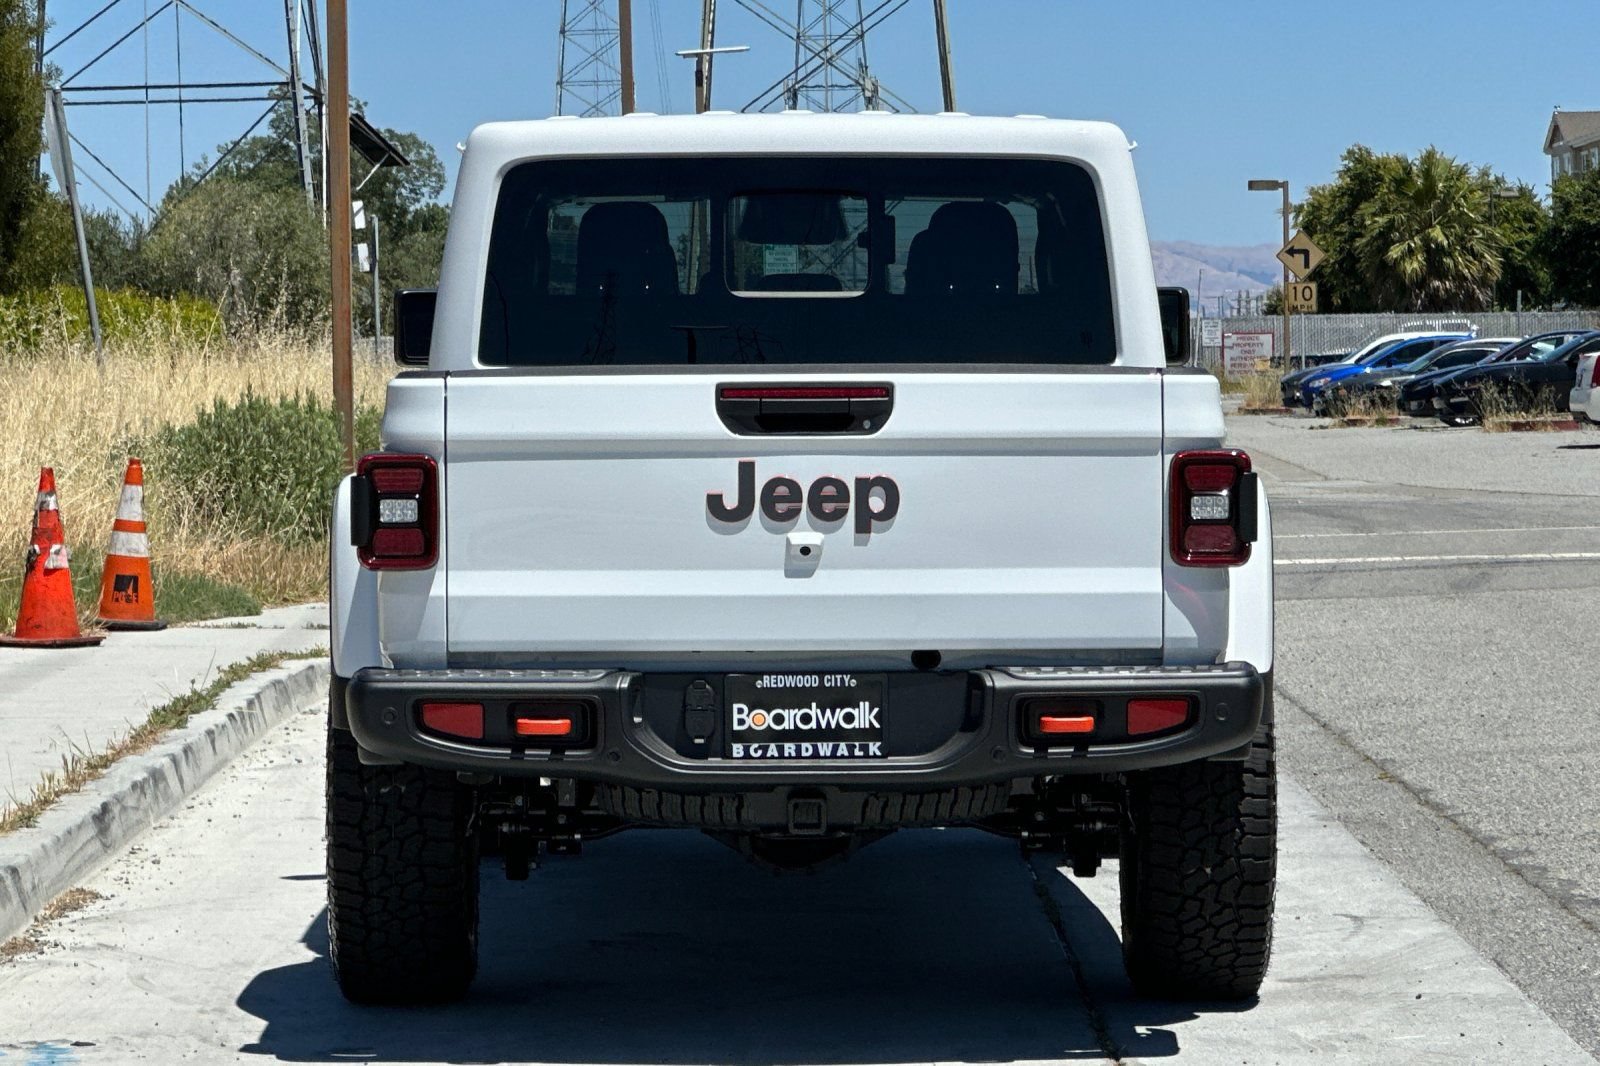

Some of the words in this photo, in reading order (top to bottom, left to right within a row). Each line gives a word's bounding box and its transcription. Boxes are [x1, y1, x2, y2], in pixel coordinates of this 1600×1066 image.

[1293, 286, 1313, 301] 10
[706, 459, 901, 535] Jeep
[763, 675, 819, 688] REDWOOD
[824, 674, 850, 687] CITY
[732, 701, 881, 731] Boardwalk
[732, 742, 882, 757] BOARDWALK
